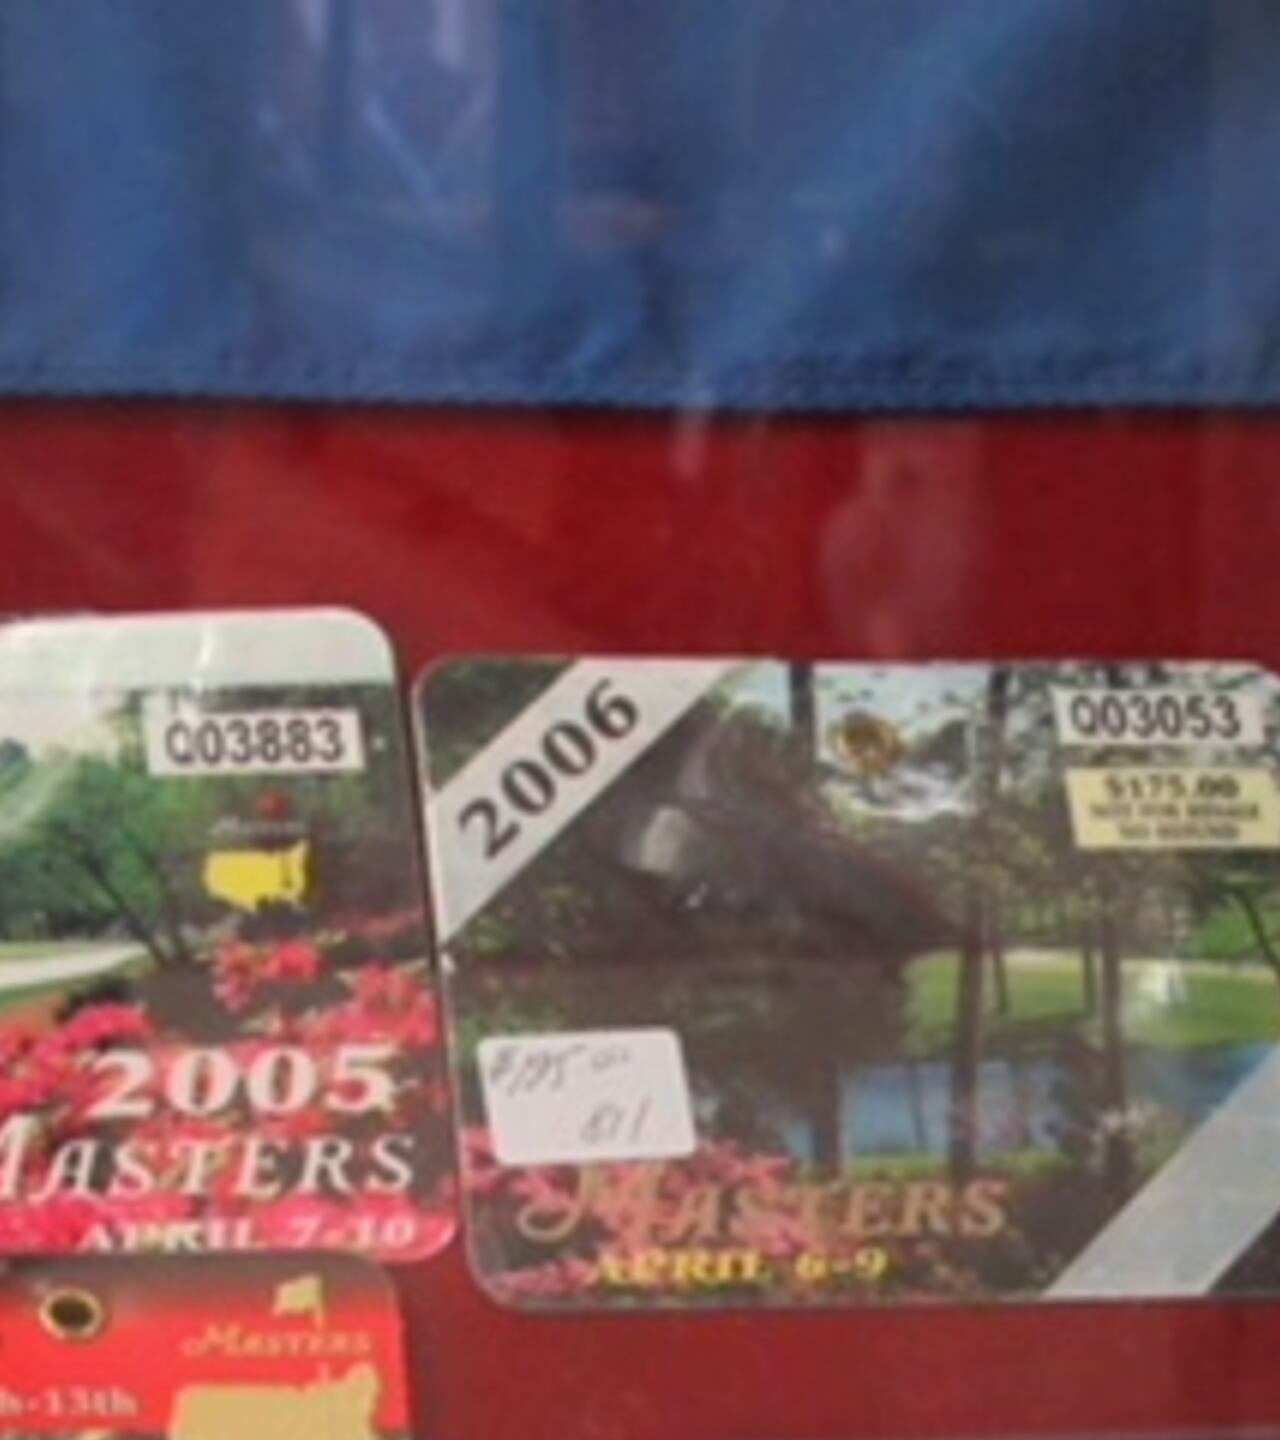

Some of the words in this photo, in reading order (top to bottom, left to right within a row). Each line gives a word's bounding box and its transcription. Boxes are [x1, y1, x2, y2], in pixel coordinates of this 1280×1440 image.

[1072, 693, 1241, 739] Q03053
[165, 718, 344, 765] Q03883
[455, 679, 641, 860] 2006
[87, 1045, 401, 1117] 2005
[518, 1162, 1010, 1244] MASTERS
[78, 1217, 253, 1254] APRIL
[273, 1216, 418, 1251] 7-10
[588, 1249, 771, 1287] APRIL
[794, 1247, 890, 1282] 6-9
